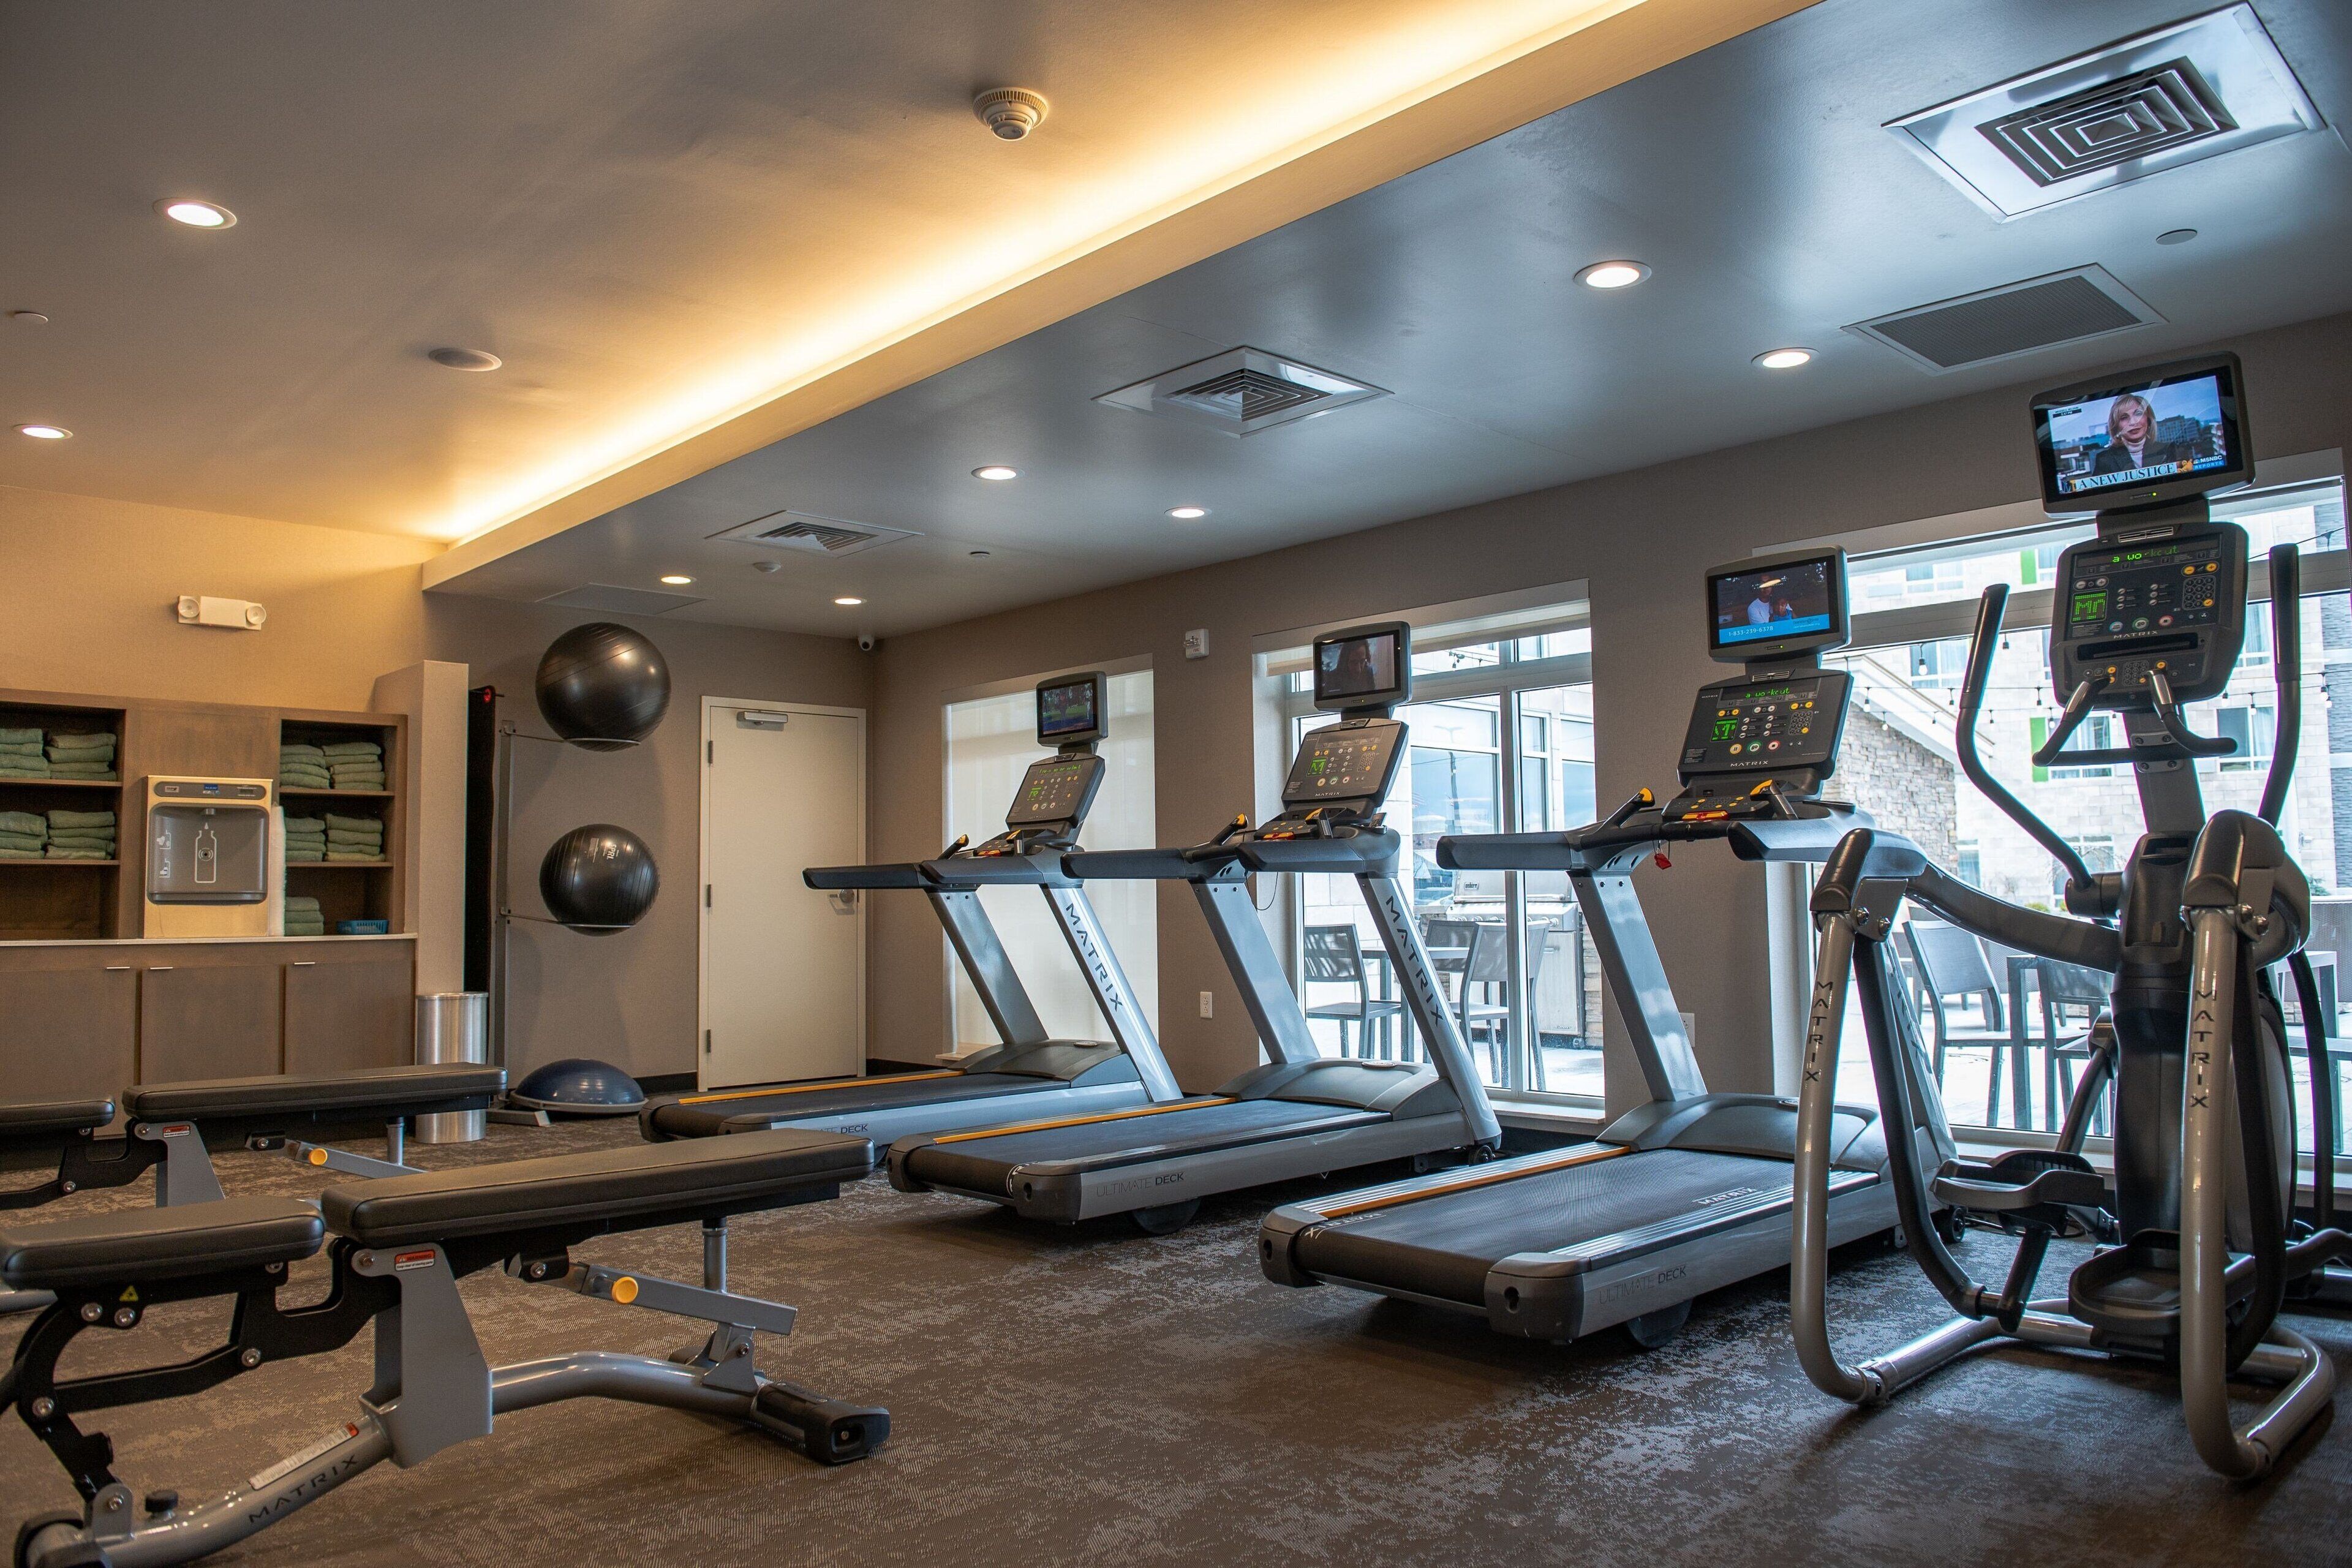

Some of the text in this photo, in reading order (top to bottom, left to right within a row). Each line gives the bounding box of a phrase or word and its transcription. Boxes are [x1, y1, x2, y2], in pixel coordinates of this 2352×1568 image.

[2079, 463, 2175, 488] A NEW JUSTICE
[1728, 625, 1774, 637] 1-833-239-6378
[2114, 630, 2158, 639] MATRIX
[1066, 903, 1123, 1012] MATRIX
[1385, 895, 1443, 1028] MATRIX
[1804, 981, 1834, 1082] MATRIX
[2191, 989, 2217, 1109] MATRIX
[840, 1123, 869, 1134] DECK
[1096, 1171, 1185, 1197] ULTIMATE DECK
[1697, 1188, 1757, 1205] MATRIX
[1599, 1266, 1687, 1304] ULTIMATE DECK
[248, 1453, 357, 1523] MATRIX
